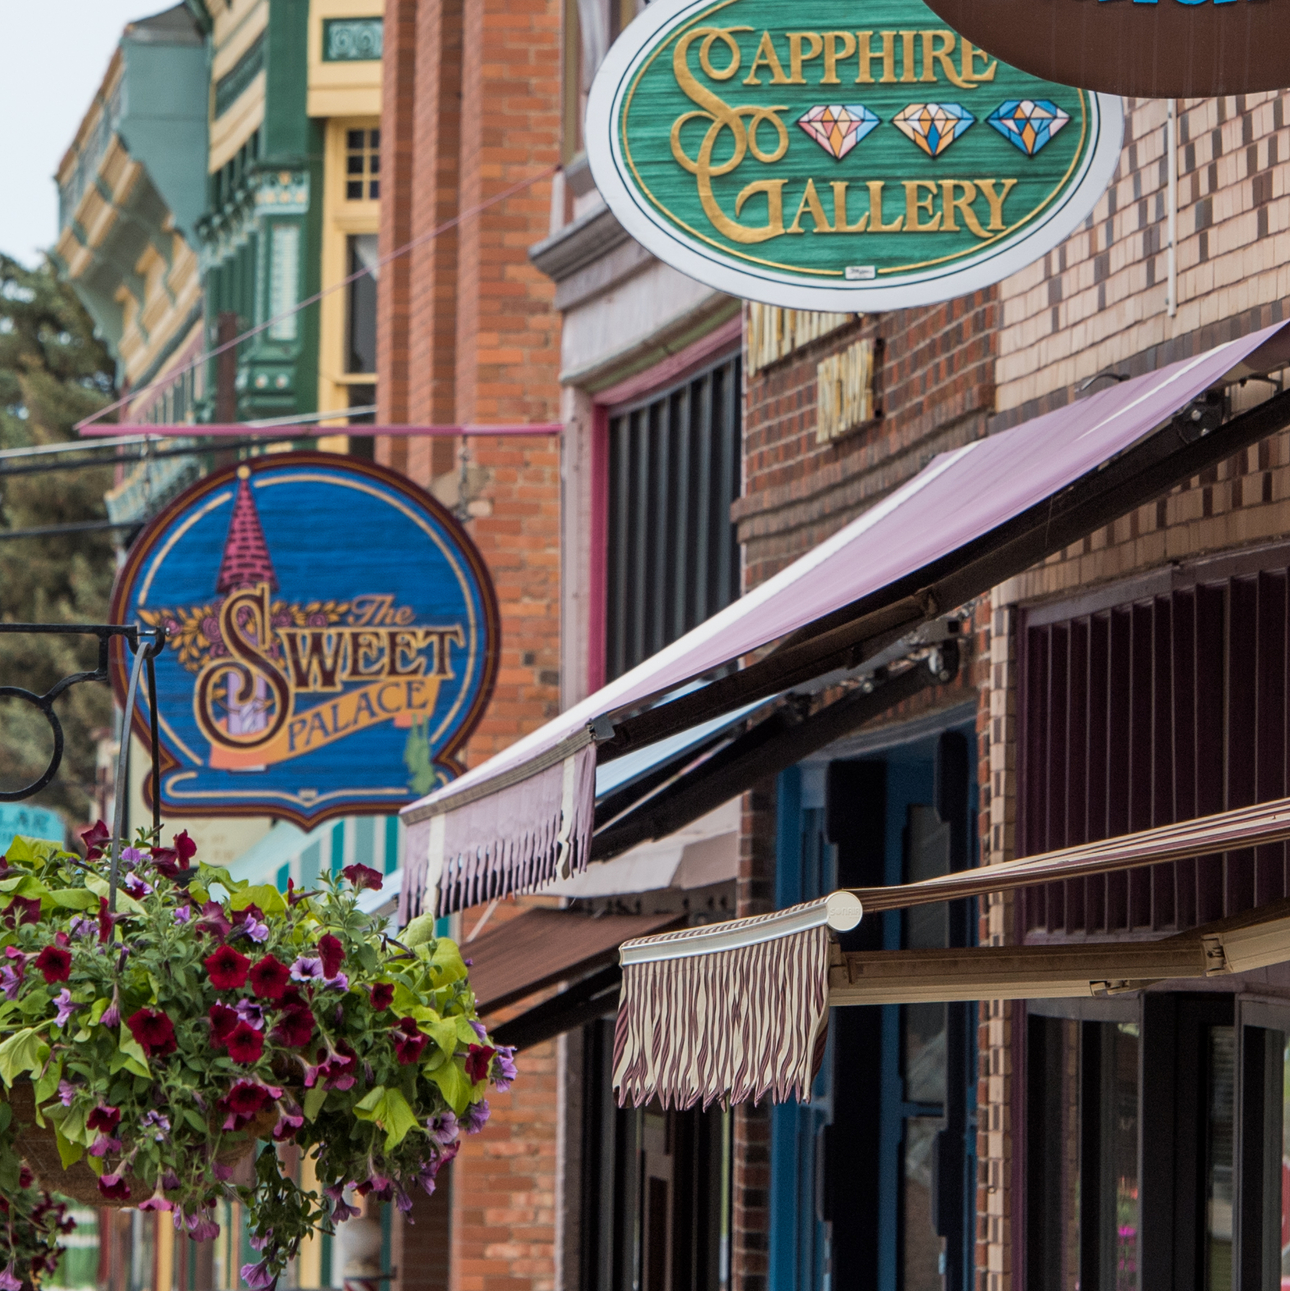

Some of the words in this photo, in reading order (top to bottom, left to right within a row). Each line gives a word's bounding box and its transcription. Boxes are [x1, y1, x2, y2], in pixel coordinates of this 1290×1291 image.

[672, 24, 998, 155] SAPPHIRE
[697, 155, 1018, 243] GALLERY
[347, 593, 417, 627] The
[286, 679, 430, 753] PALACE
